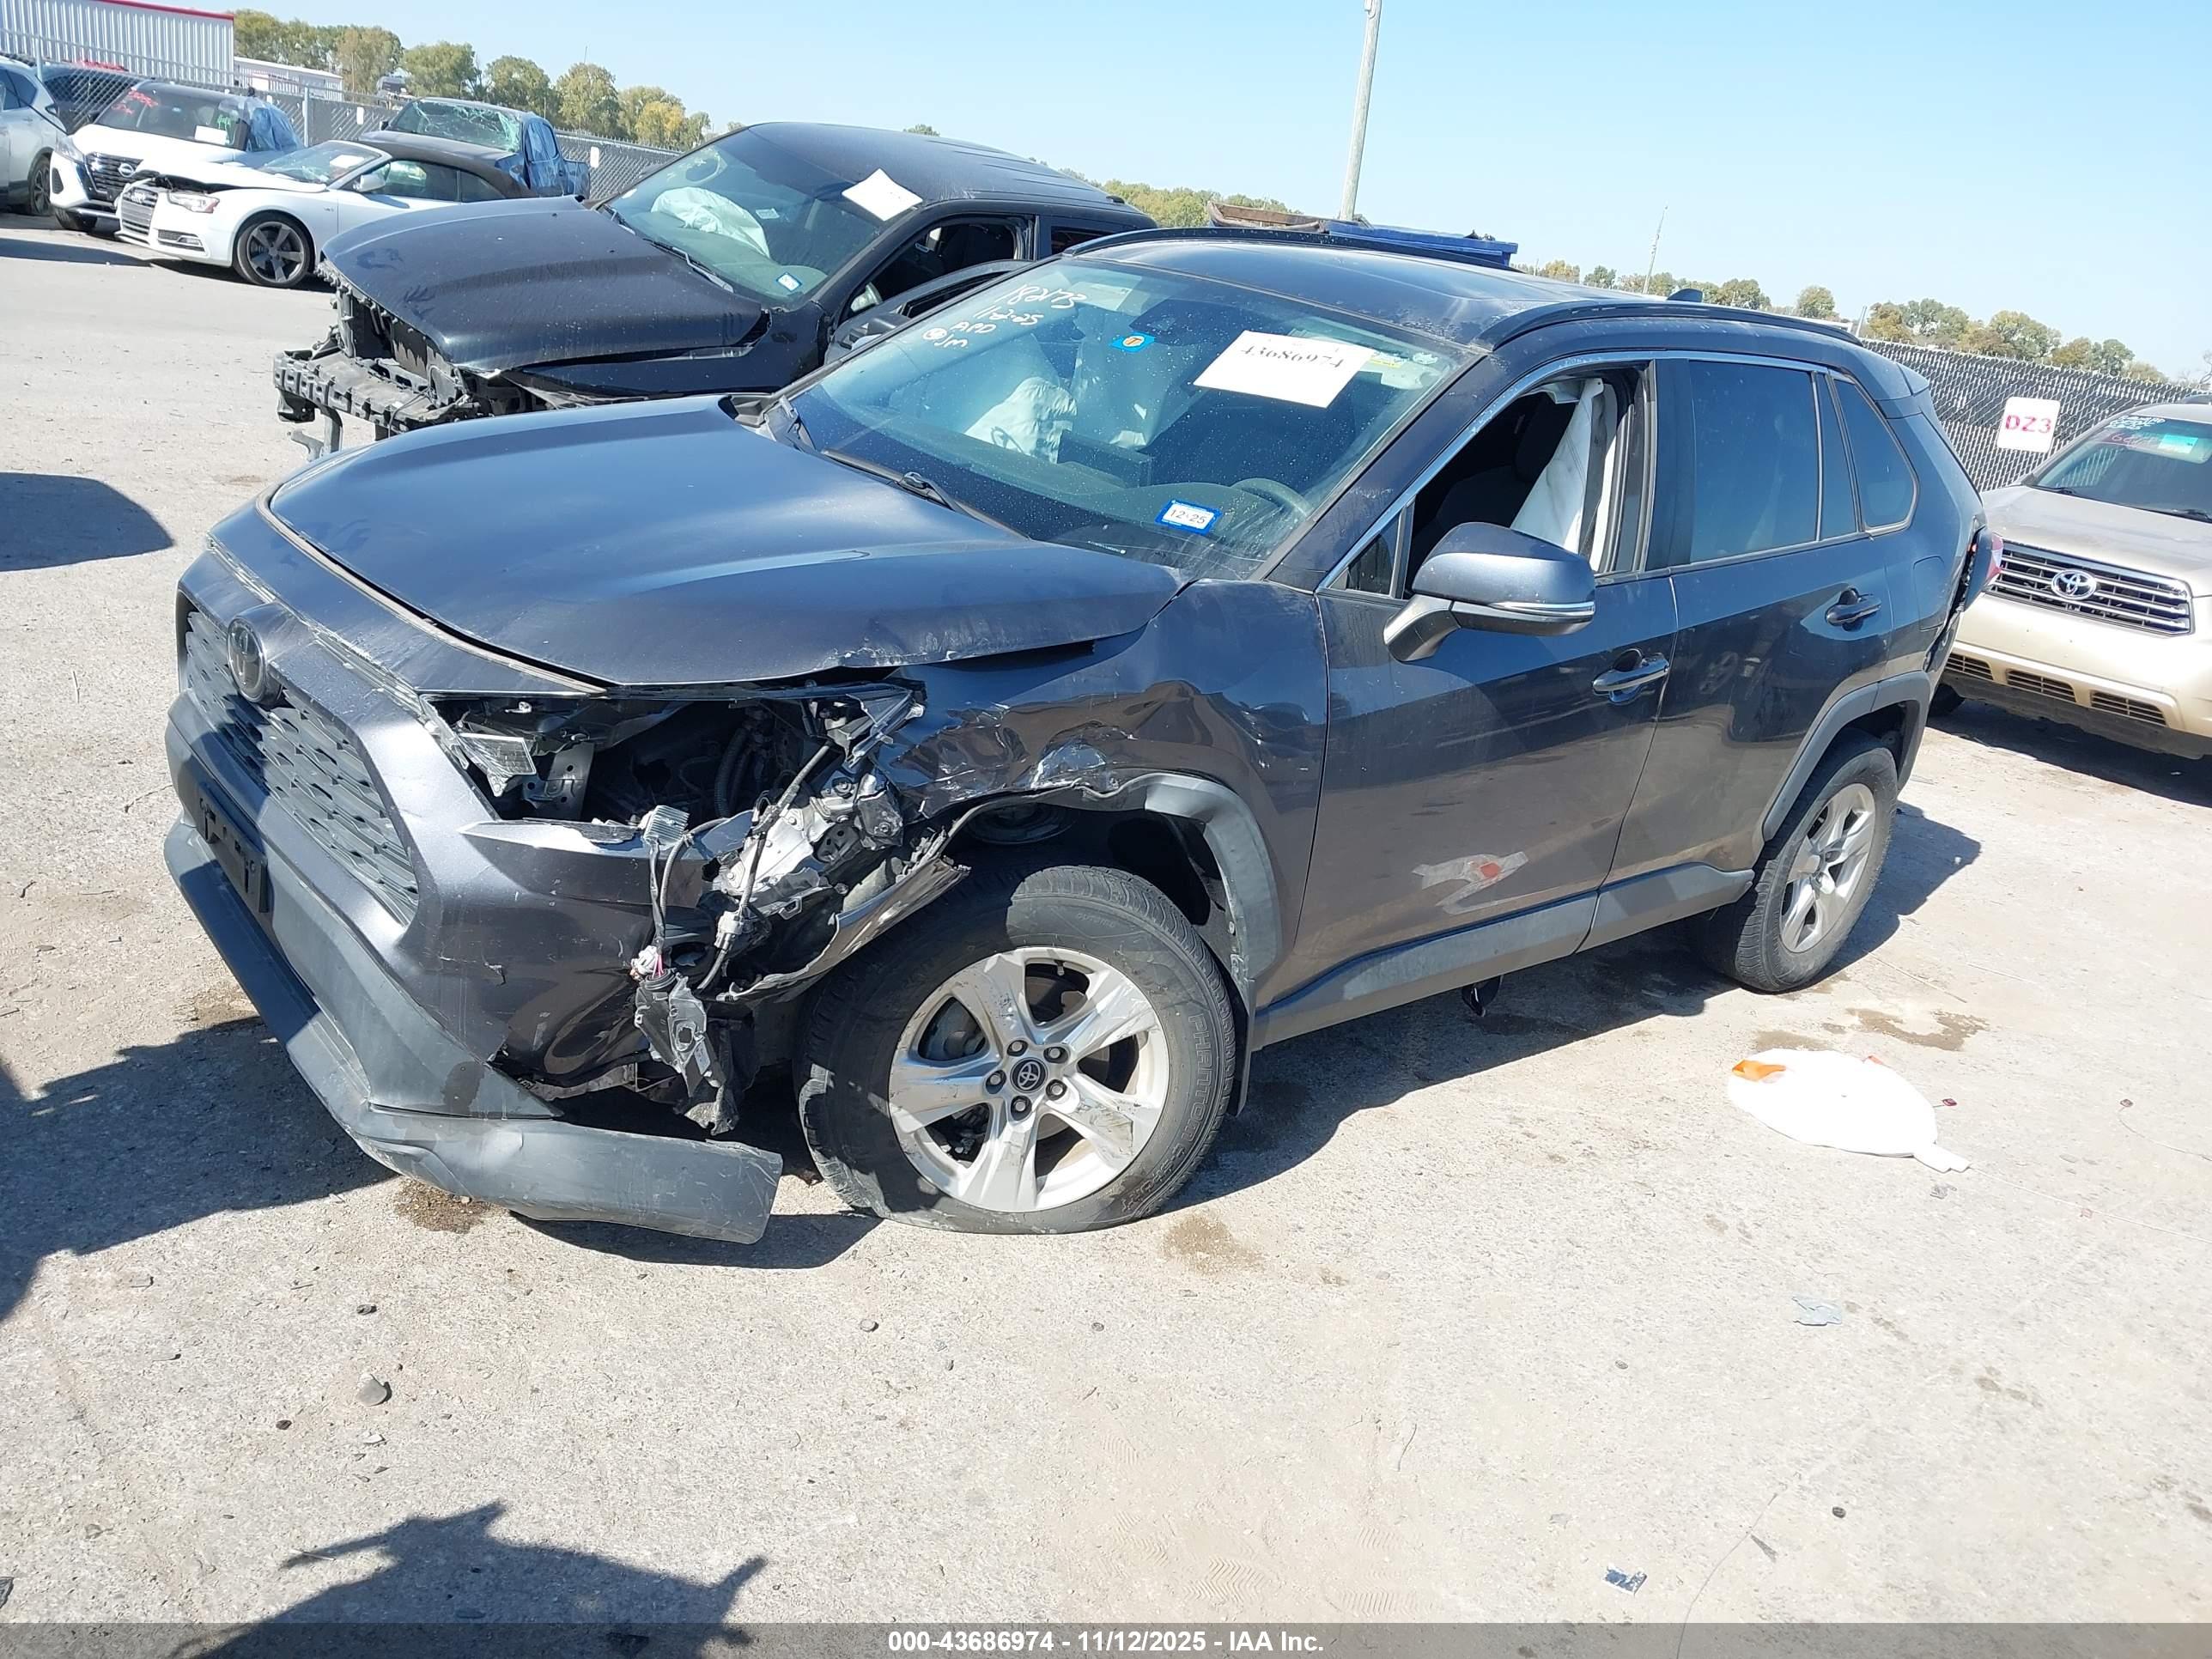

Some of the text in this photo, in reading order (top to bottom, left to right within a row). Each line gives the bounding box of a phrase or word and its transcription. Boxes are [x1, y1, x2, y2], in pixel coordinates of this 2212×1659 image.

[1240, 345, 1345, 368] 43686974
[2005, 415, 2052, 434] DZ3
[1182, 1012, 1213, 1142] PHANTOM
